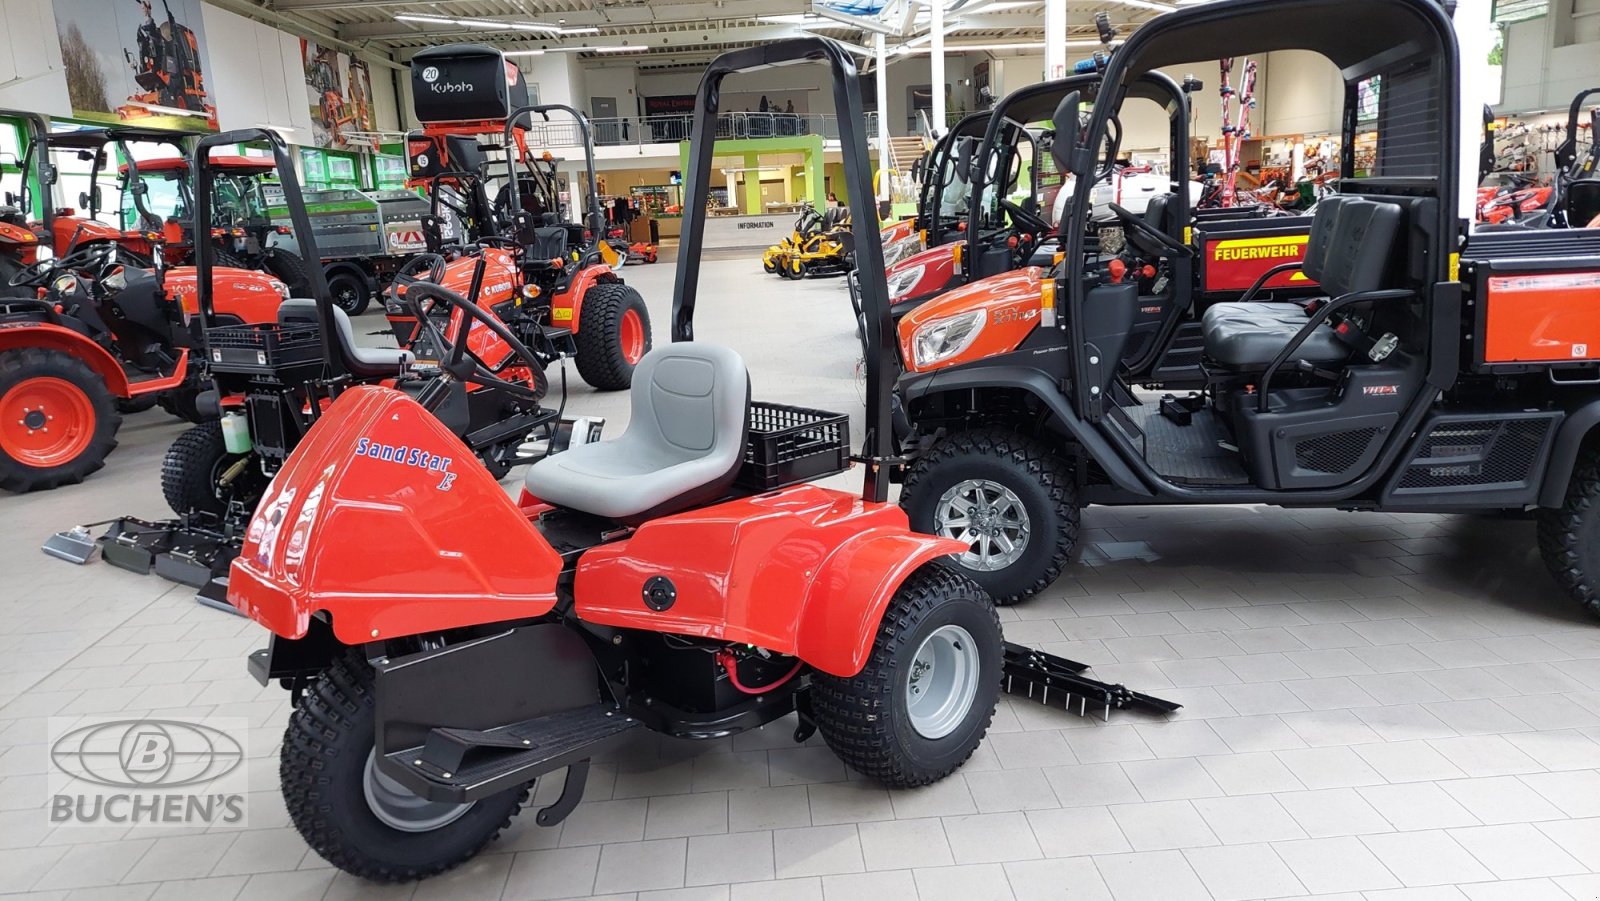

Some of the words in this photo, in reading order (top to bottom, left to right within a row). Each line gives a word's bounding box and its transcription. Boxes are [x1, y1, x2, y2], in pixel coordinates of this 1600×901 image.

[425, 69, 437, 79] 20
[430, 81, 473, 94] Kubota
[419, 156, 427, 166] 15
[737, 221, 774, 230] INFORMATION
[1214, 245, 1299, 261] FEUERWEHR
